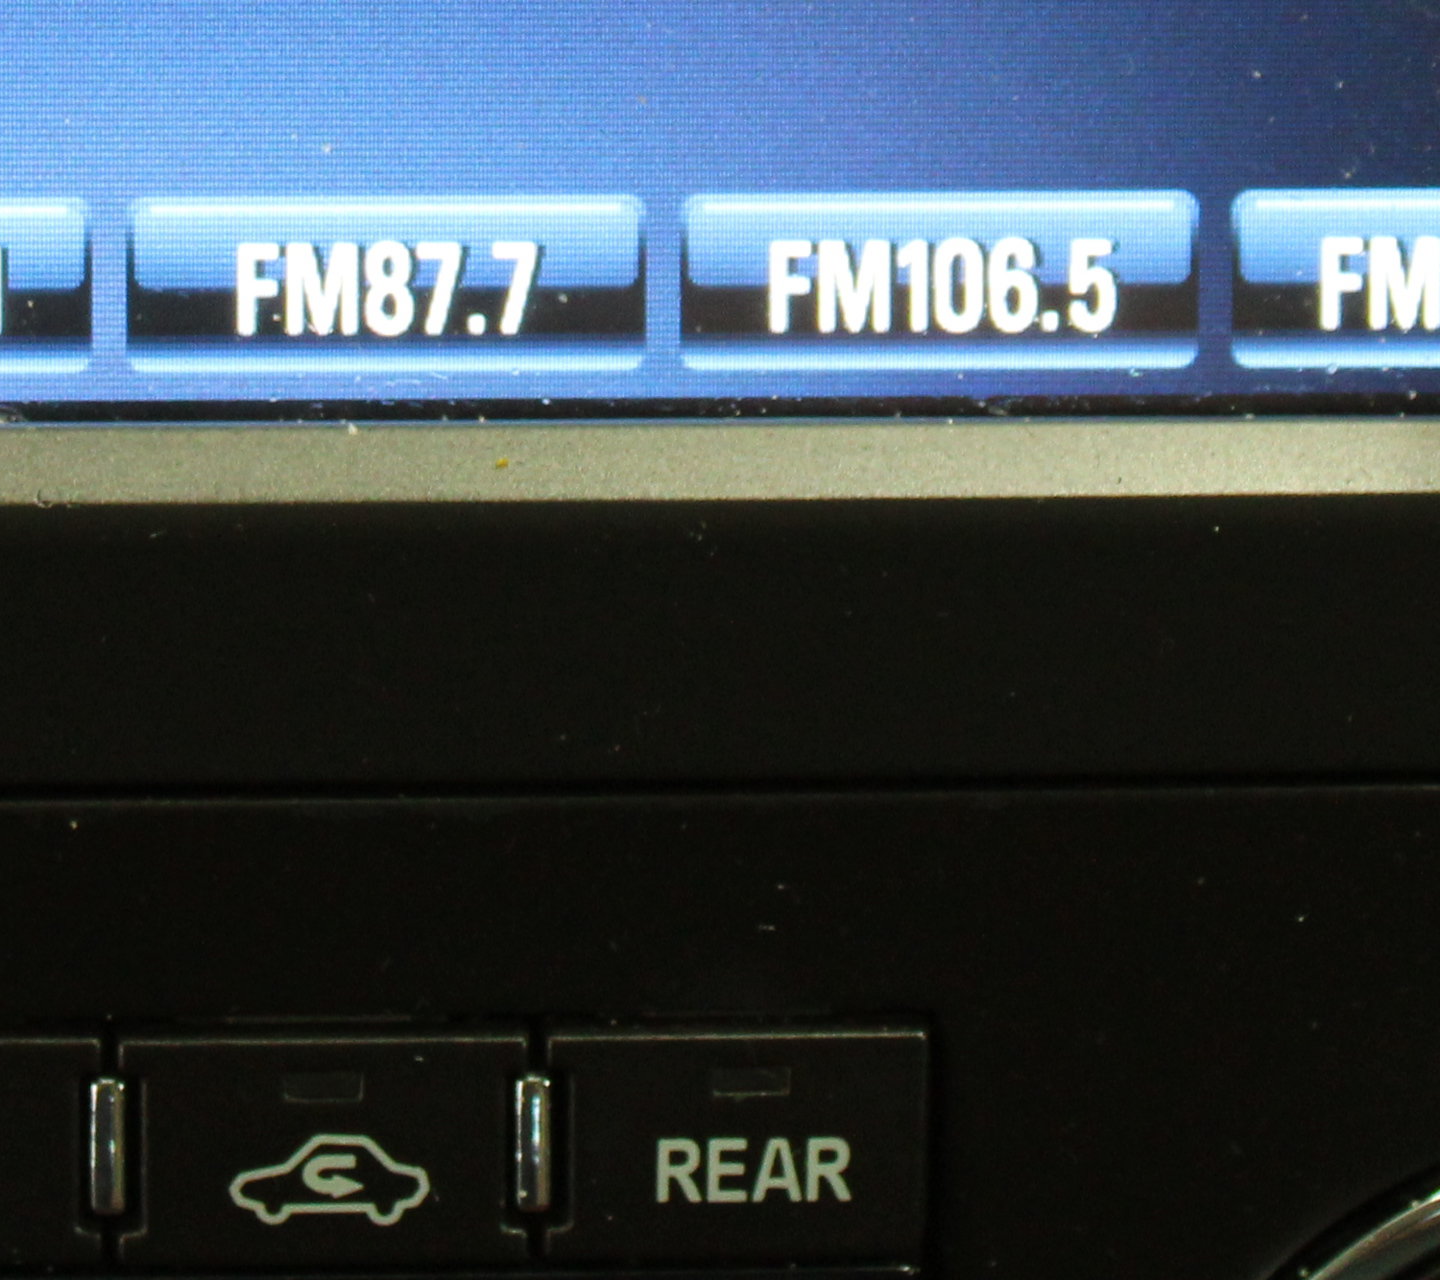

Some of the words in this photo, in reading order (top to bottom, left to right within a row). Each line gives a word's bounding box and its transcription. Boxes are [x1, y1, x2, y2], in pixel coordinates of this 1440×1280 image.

[234, 241, 538, 337] FM87.7
[766, 240, 1119, 335] FM106.5
[654, 1136, 851, 1204] REAR
